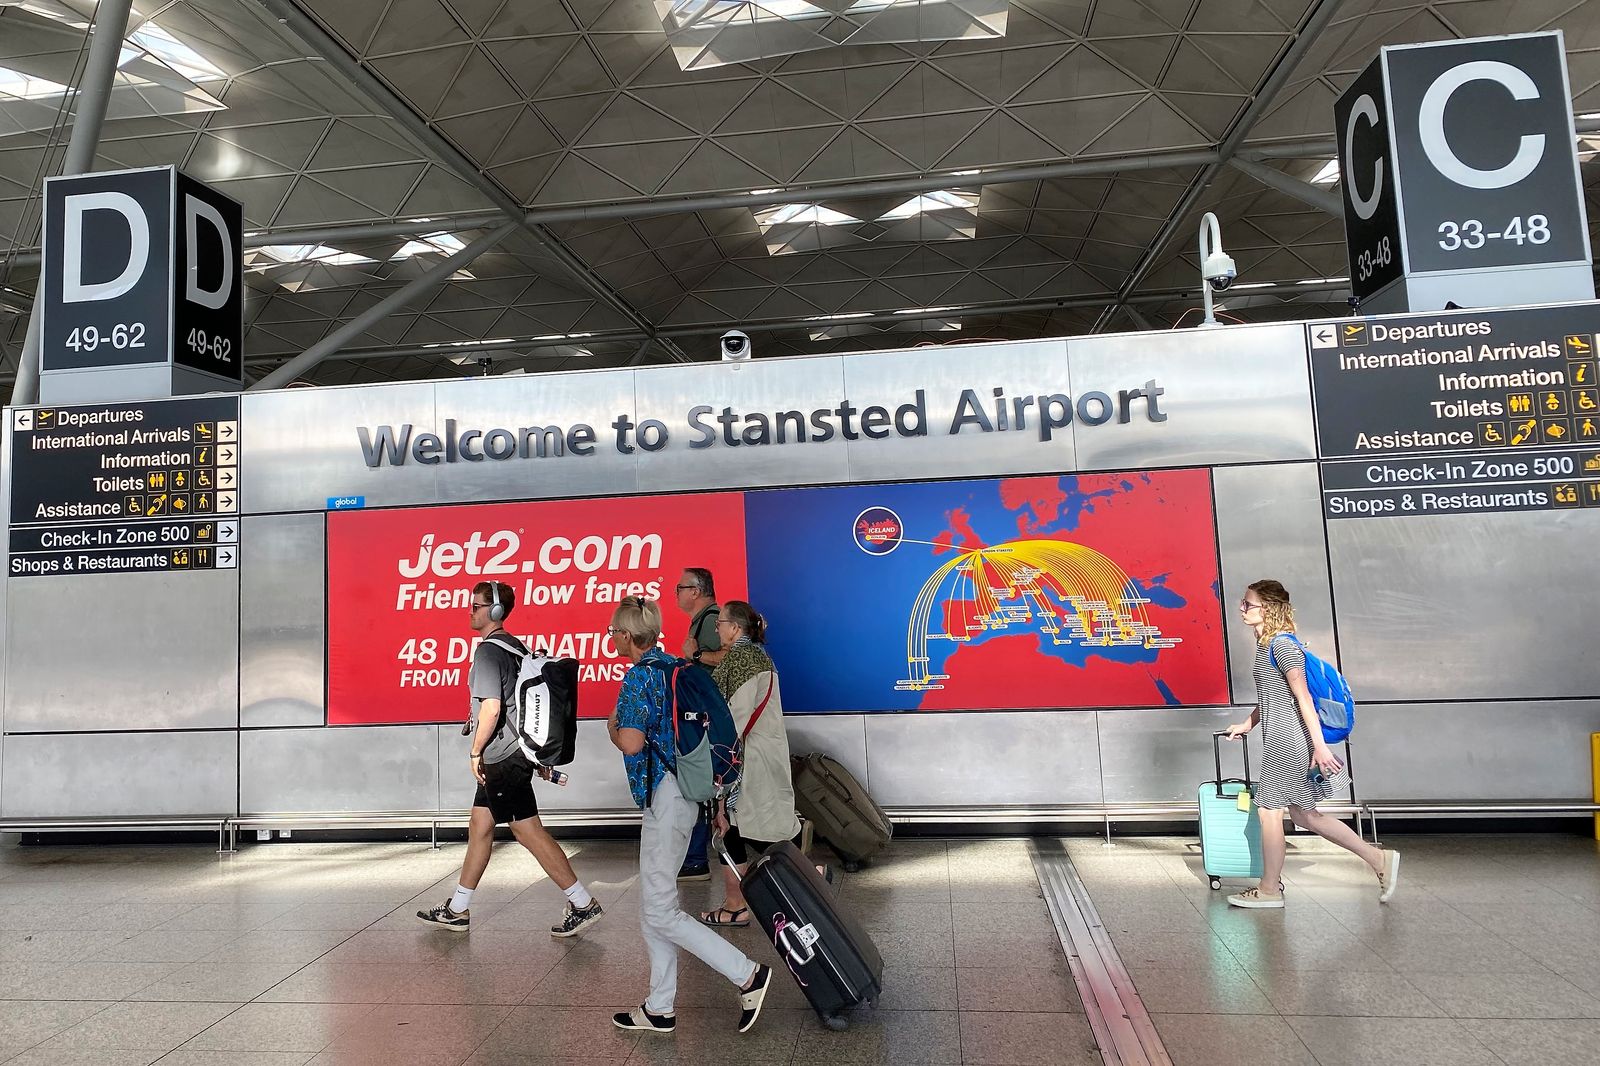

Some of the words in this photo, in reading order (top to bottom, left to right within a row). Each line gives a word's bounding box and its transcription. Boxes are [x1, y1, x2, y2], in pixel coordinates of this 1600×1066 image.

[1418, 60, 1546, 189] C
[1345, 93, 1384, 220] C
[1437, 214, 1551, 251] 33-48
[62, 191, 150, 304] D
[185, 193, 233, 310] D
[1357, 235, 1392, 282] 33-48
[65, 322, 146, 352] 49-62
[187, 327, 232, 363] 49-62
[1371, 321, 1492, 344] Departures
[1339, 346, 1473, 371] International
[1477, 340, 1561, 362] Arrivals
[1438, 369, 1565, 391] Information
[58, 409, 144, 428] Departures
[1430, 399, 1504, 419] Toilets
[356, 418, 597, 468] Welcome
[611, 413, 671, 456] to
[687, 389, 928, 448] Stansted
[949, 379, 1168, 442] Airport
[32, 430, 128, 450] International
[131, 426, 191, 444] Arrivals
[1354, 430, 1474, 450] Assistance
[101, 450, 191, 469] Information
[1366, 461, 1466, 484] Check-In
[1470, 460, 1529, 479] Zone
[1533, 456, 1574, 475] 500
[93, 476, 144, 493] Toilets
[35, 501, 121, 519] Assistance
[335, 498, 357, 508] global
[1329, 494, 1396, 516] Shops
[1401, 494, 1417, 511] &
[1421, 489, 1548, 511] Restaurants
[40, 528, 112, 548] Check-In
[116, 528, 157, 544] Zone
[160, 525, 190, 542] 500
[11, 557, 59, 575] Shops
[62, 555, 74, 571] &
[78, 549, 168, 570] Restaurants
[396, 580, 517, 611] Frien
[523, 579, 576, 606] low
[585, 576, 661, 603] fares
[398, 638, 438, 665] 48
[400, 668, 460, 688] FROM
[533, 693, 541, 734] MAMMUT
